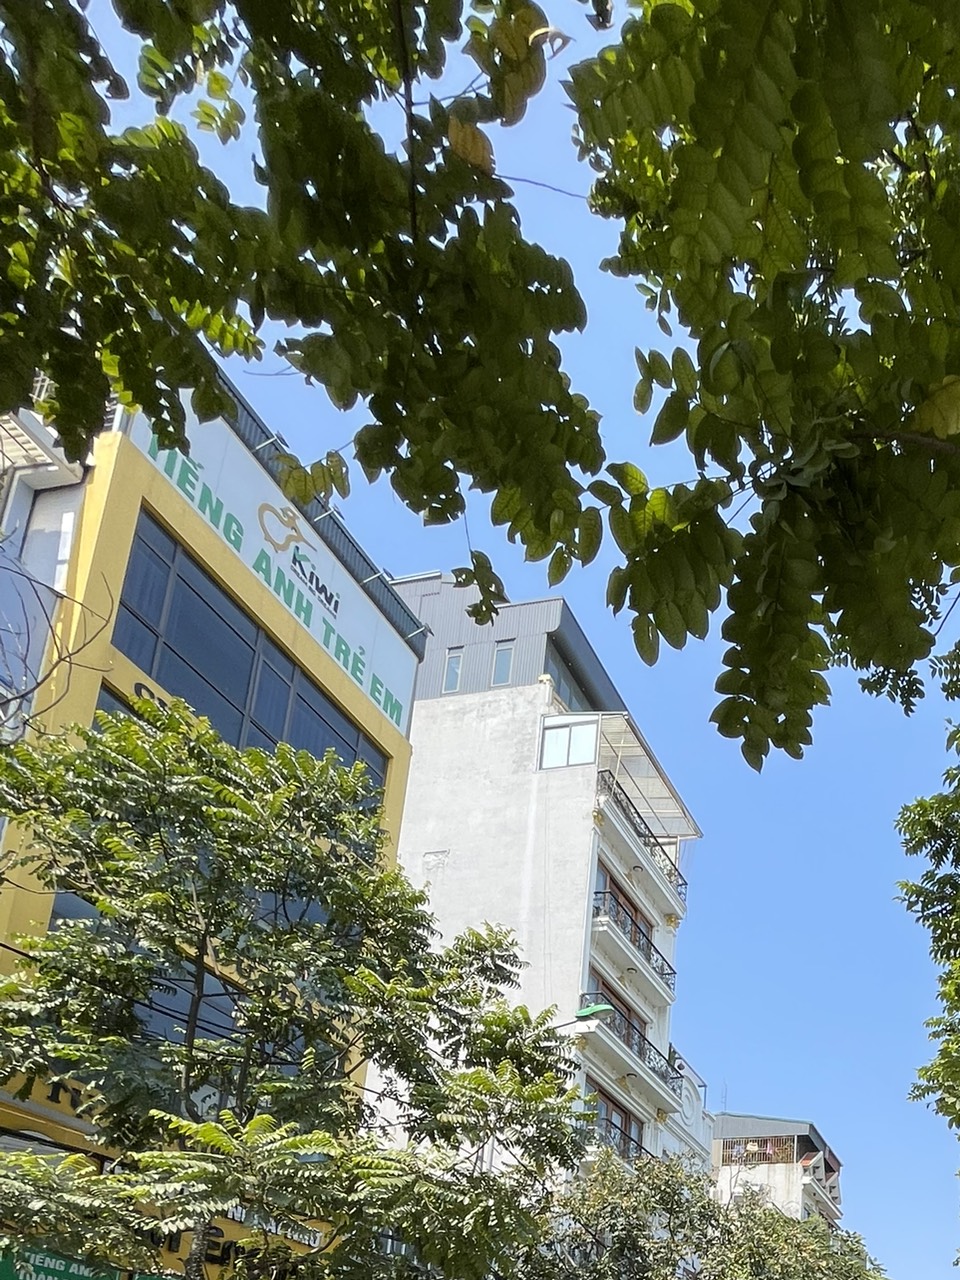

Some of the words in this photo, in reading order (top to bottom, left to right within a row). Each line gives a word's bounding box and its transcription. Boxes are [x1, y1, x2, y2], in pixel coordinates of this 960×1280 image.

[291, 546, 341, 615] Kiwi
[252, 548, 313, 628] ANH
[322, 616, 366, 687] TRẺ
[369, 673, 403, 728] EM
[69, 1262, 93, 1278] AN
